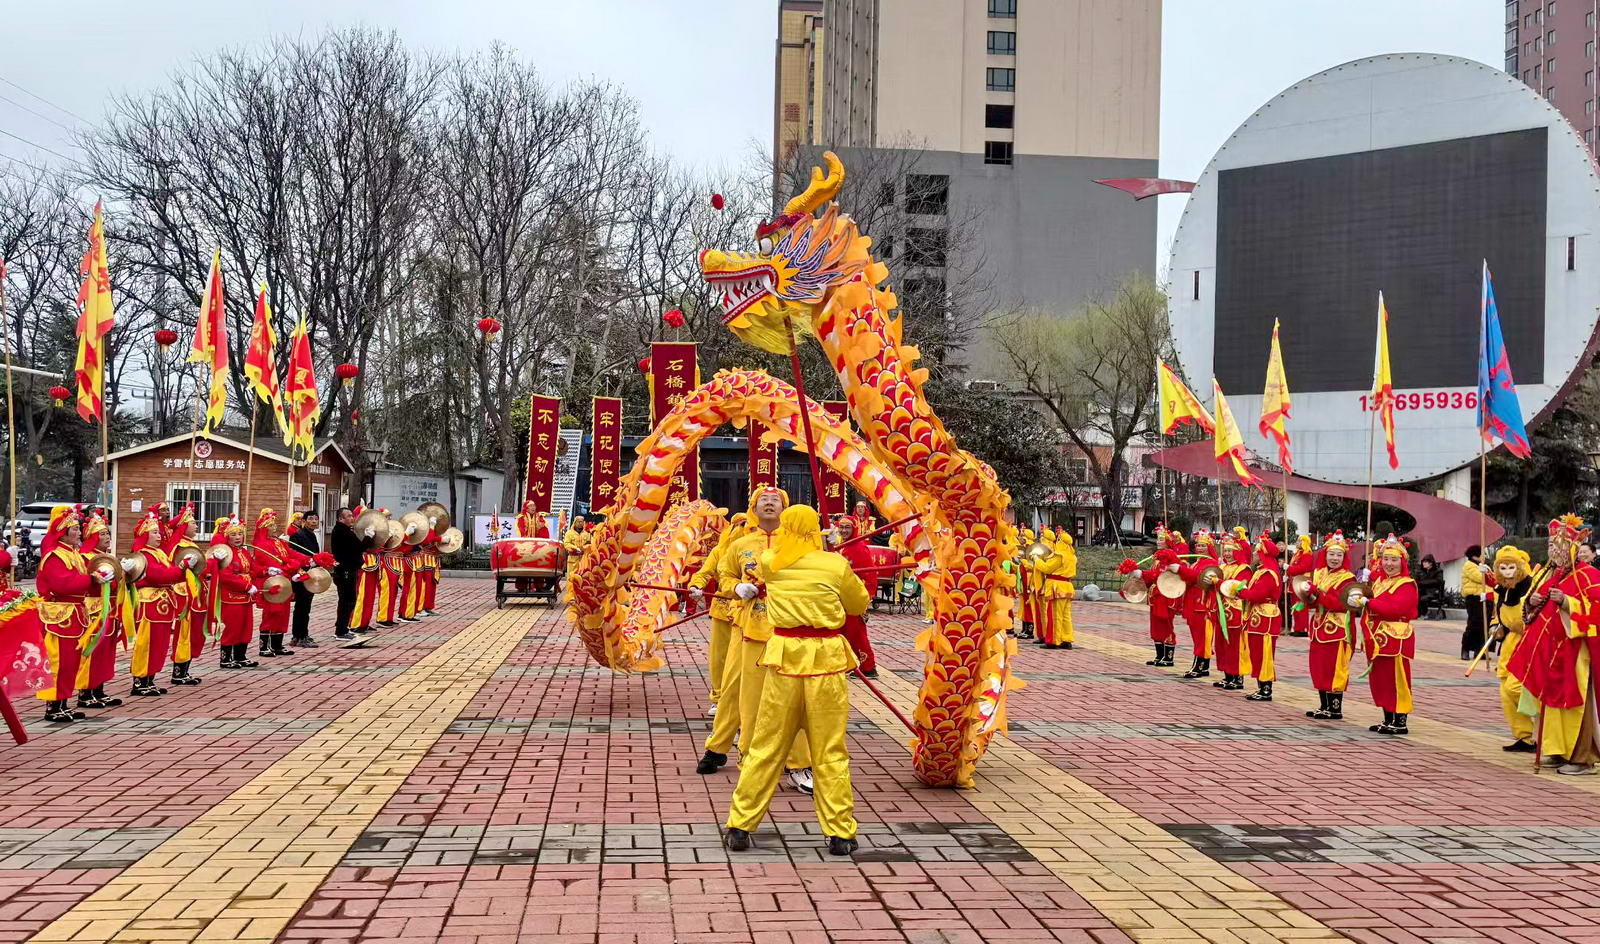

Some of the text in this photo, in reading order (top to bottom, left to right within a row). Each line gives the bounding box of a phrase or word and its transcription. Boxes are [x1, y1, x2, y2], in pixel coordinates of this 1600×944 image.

[1359, 391, 1478, 412] 13695936
[163, 458, 246, 469] 学雷锋志愿服务站
[532, 409, 553, 497] 不忘初心
[598, 411, 614, 498] 牢记使命
